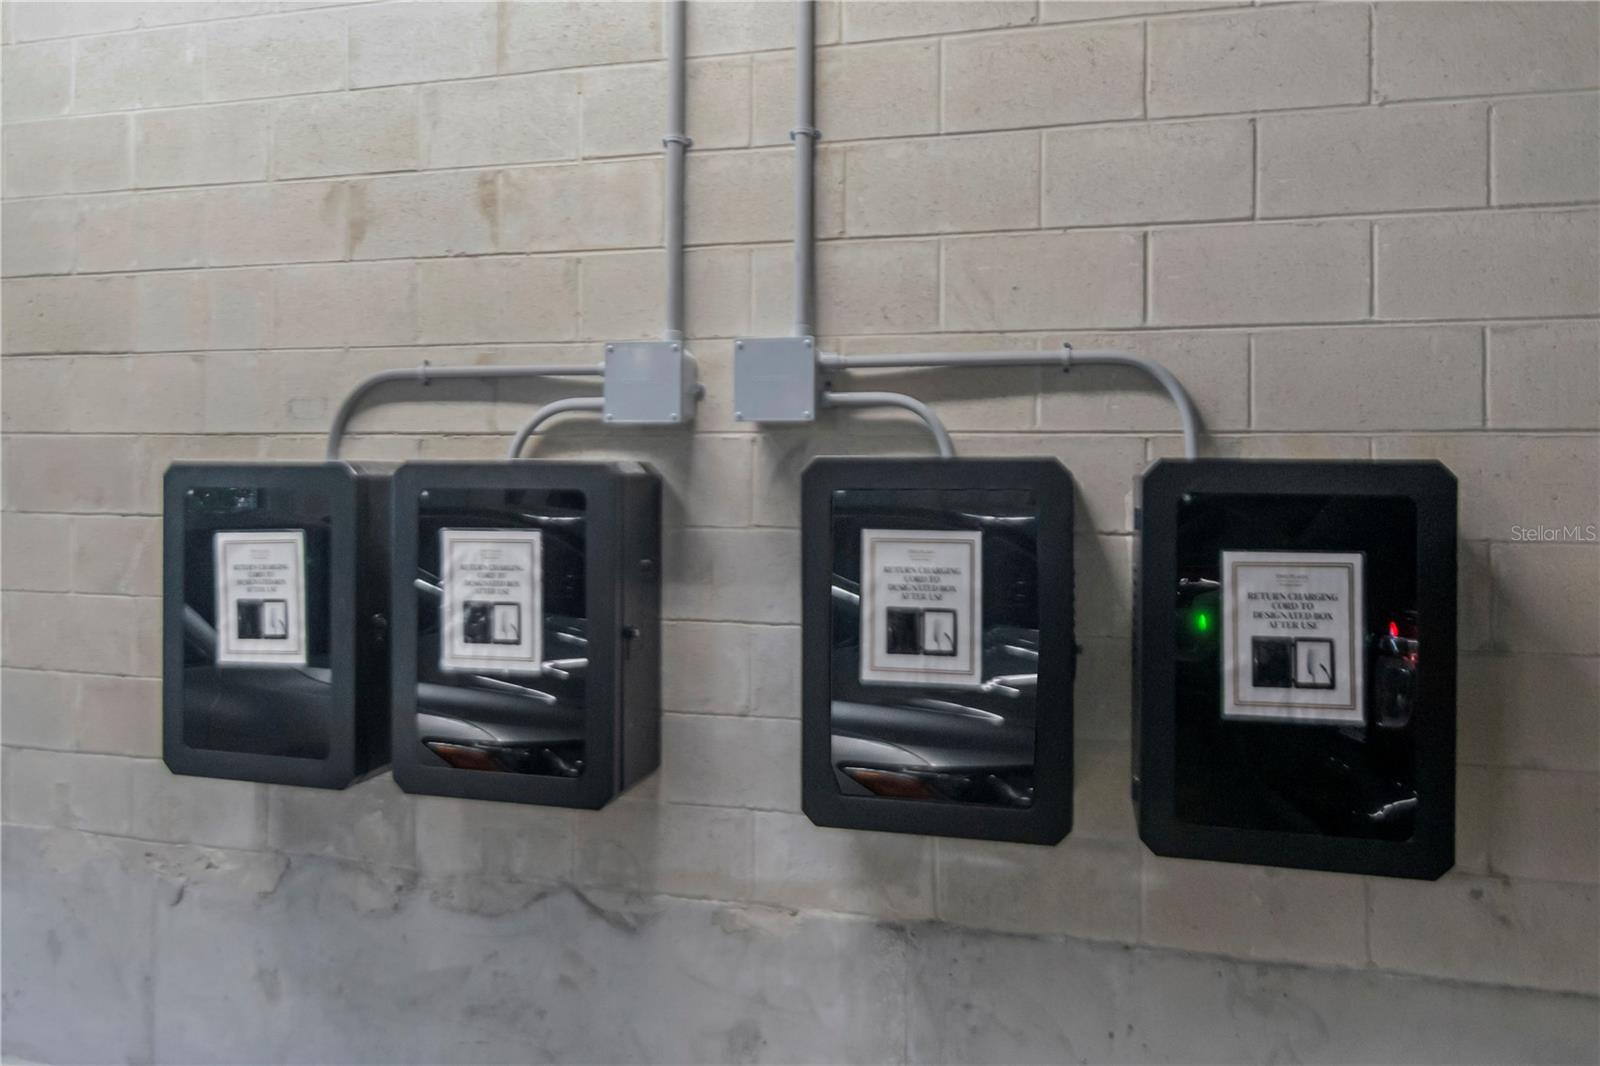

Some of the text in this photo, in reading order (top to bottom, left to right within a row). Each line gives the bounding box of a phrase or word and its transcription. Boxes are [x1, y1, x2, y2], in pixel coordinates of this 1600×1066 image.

[883, 566, 916, 574] RETURN
[1247, 592, 1339, 601] RETURN CHARGING
[1271, 602, 1314, 610] CORD TO
[1253, 611, 1333, 621] DESIGNATED BOX
[1269, 620, 1318, 630] AFTER USE
